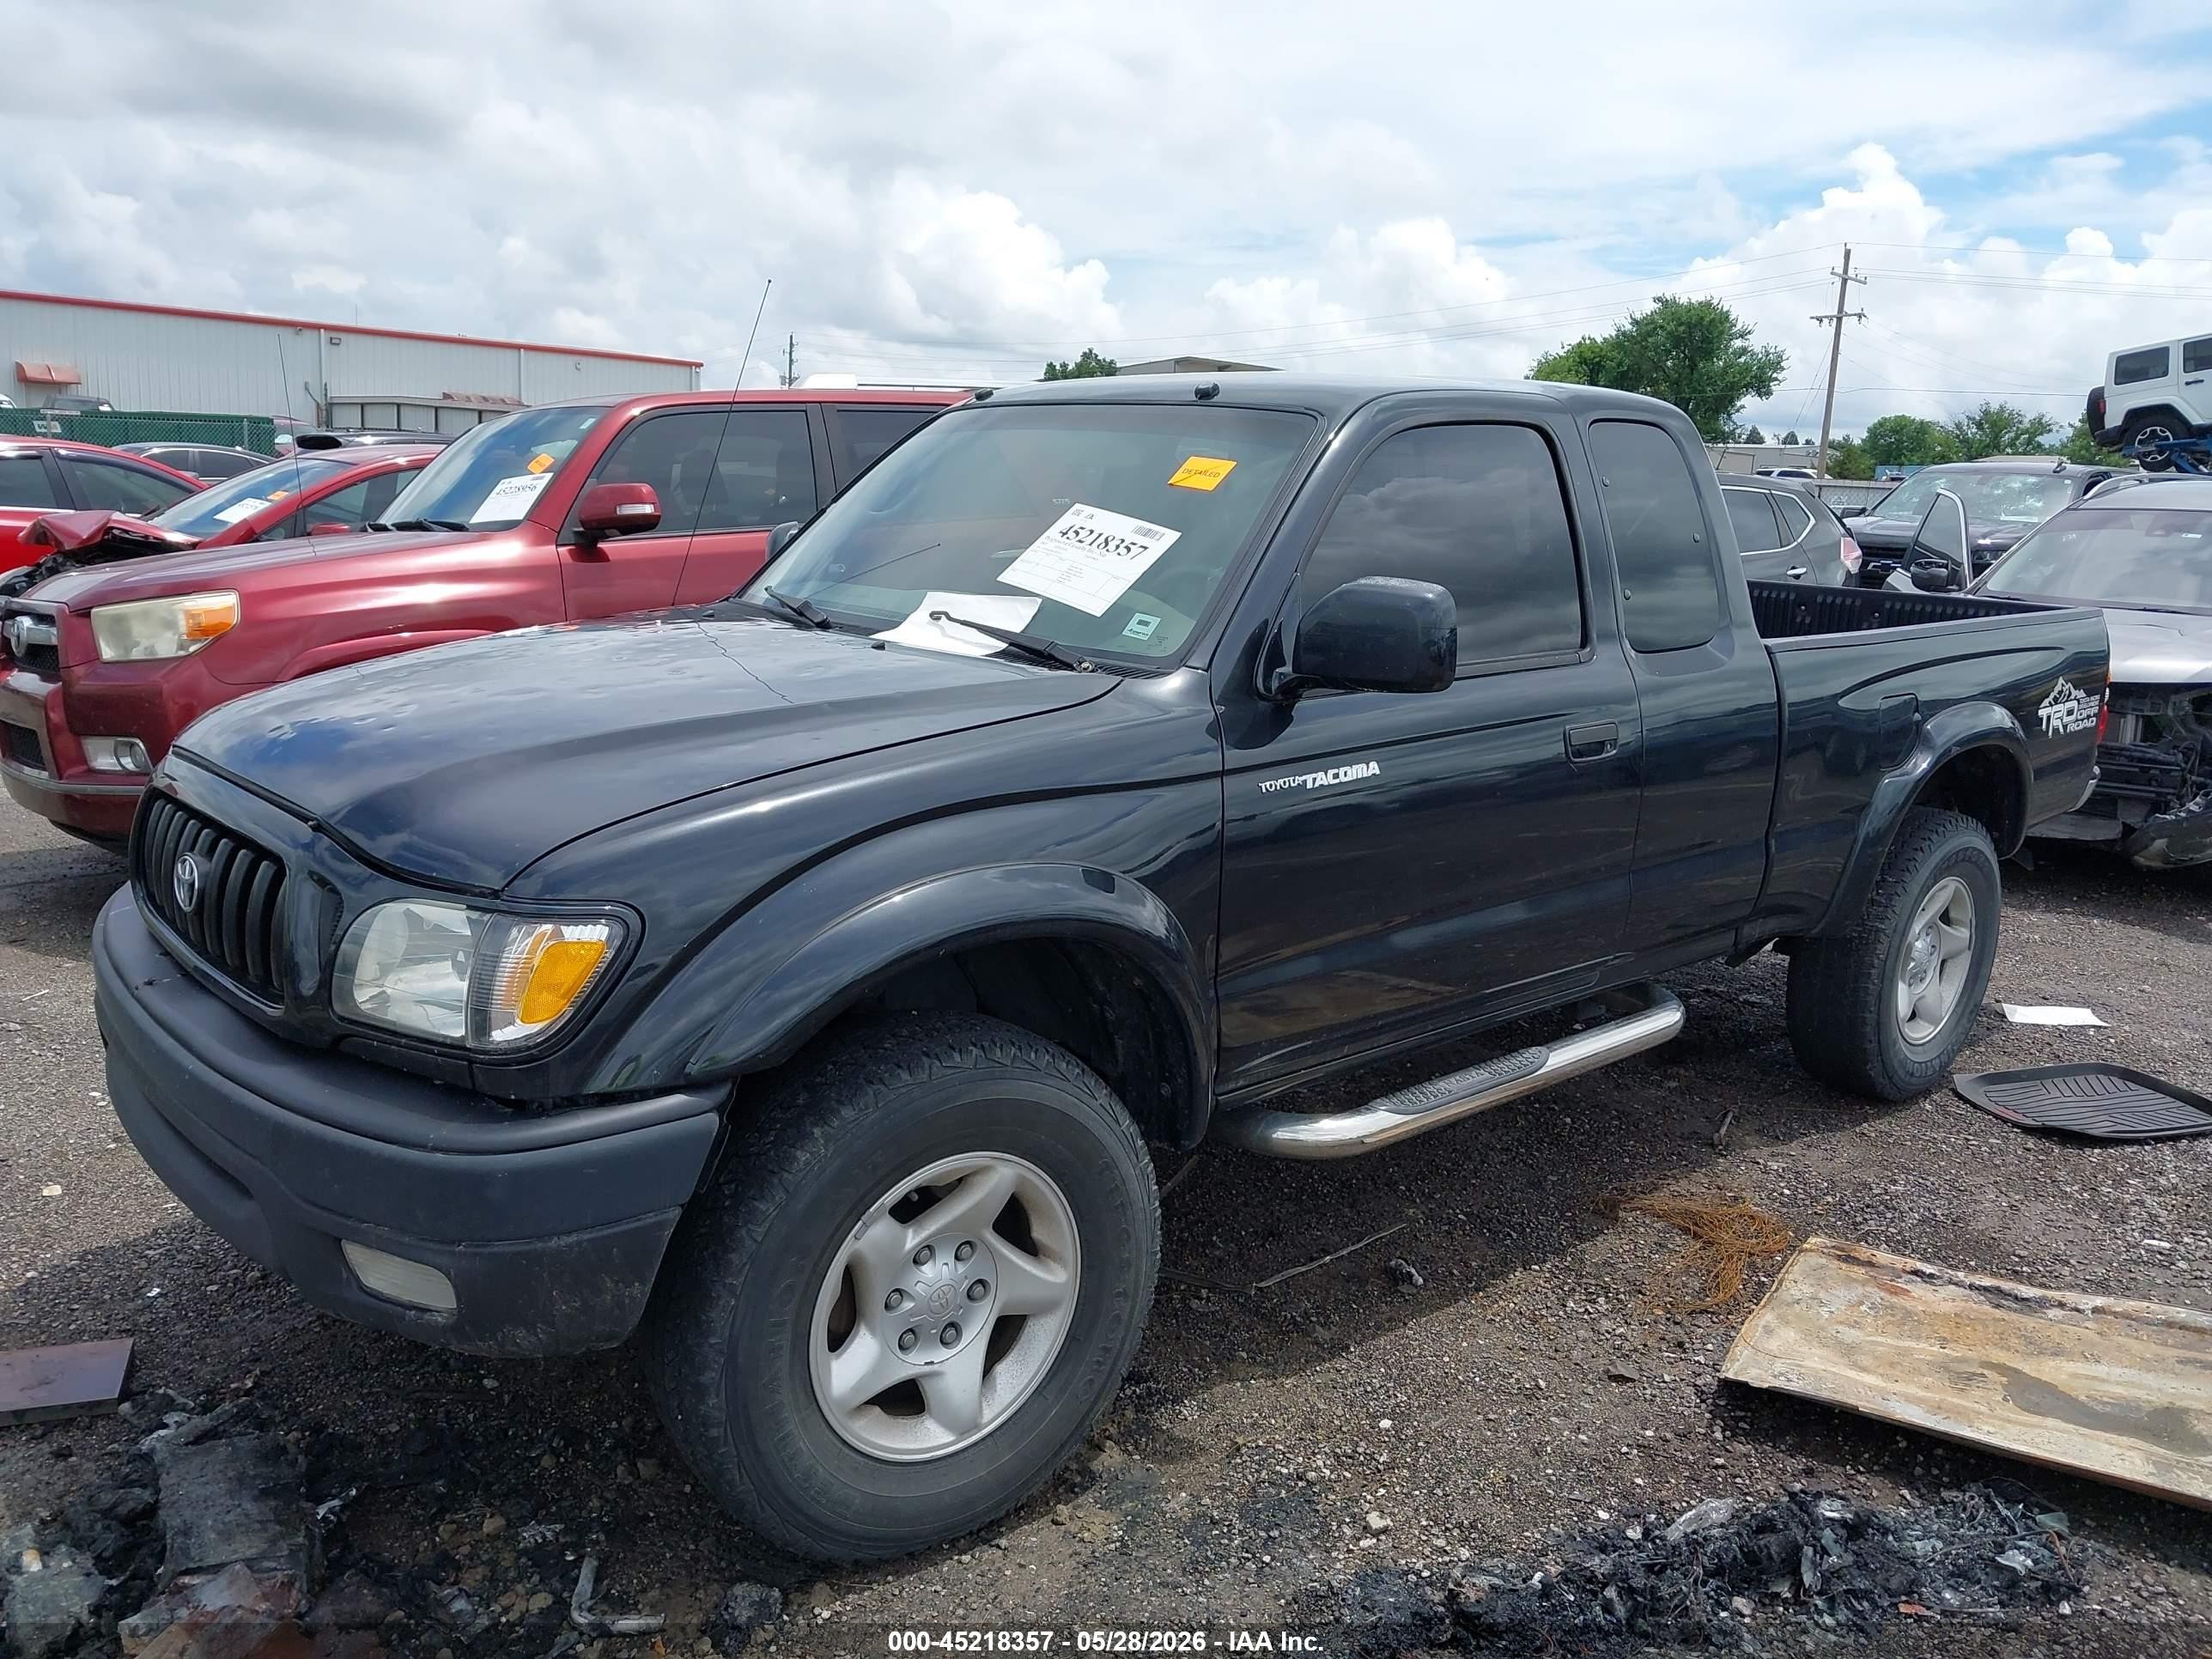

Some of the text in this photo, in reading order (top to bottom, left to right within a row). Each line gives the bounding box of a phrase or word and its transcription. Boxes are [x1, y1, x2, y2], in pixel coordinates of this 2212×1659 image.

[1058, 523, 1149, 561] 45218357
[2038, 700, 2079, 739] TRD
[2067, 716, 2097, 733] ROAD
[2077, 706, 2100, 720] OFF
[1259, 761, 1381, 793] TOYOTA TACOMA
